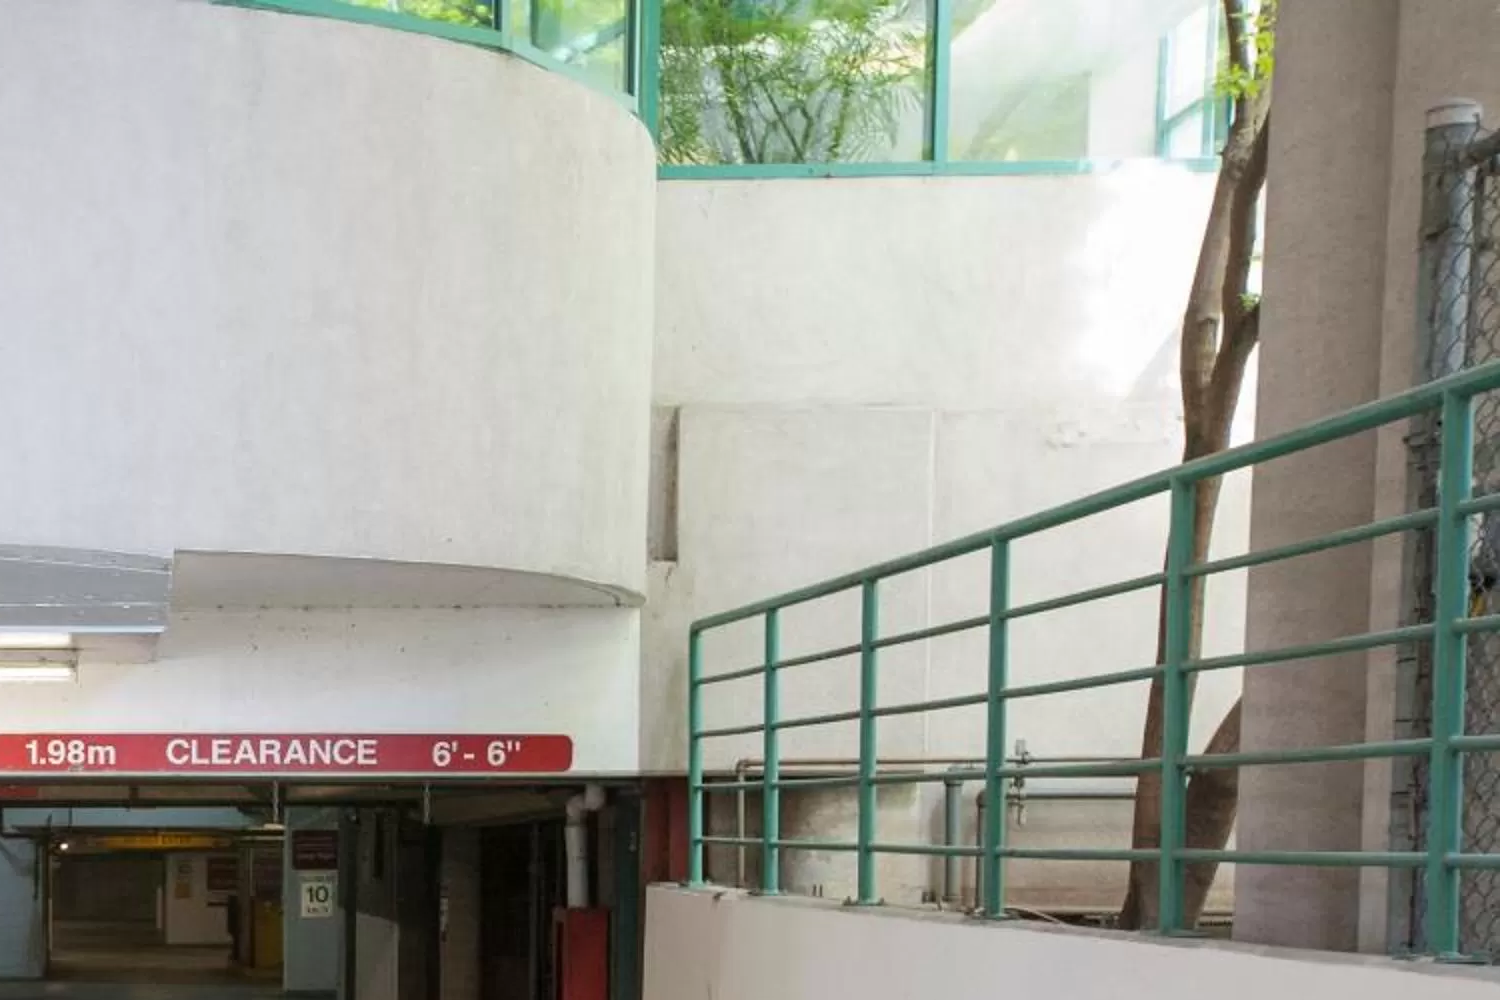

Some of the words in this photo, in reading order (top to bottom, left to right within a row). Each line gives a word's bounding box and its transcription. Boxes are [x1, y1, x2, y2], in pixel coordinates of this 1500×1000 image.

[25, 739, 117, 766] 1.98m
[165, 739, 378, 766] CLEARANCE
[432, 740, 459, 767] 6'
[306, 885, 329, 903] 10
